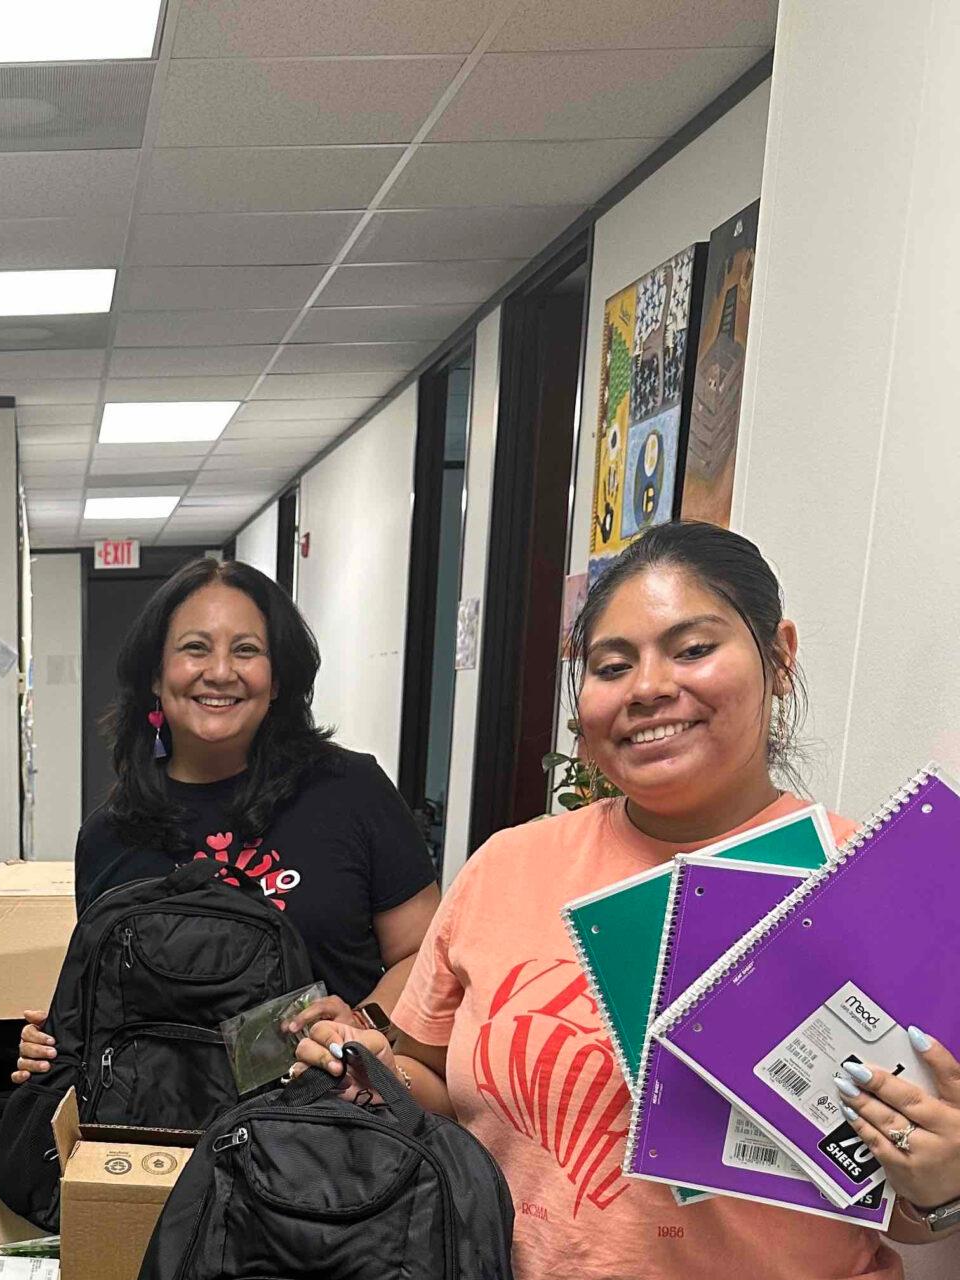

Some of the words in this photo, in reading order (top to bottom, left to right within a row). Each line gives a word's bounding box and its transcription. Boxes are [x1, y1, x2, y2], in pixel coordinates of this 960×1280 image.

[103, 542, 133, 565] EXIT
[824, 1101, 838, 1115] SFI
[826, 1142, 862, 1176] SHEETS
